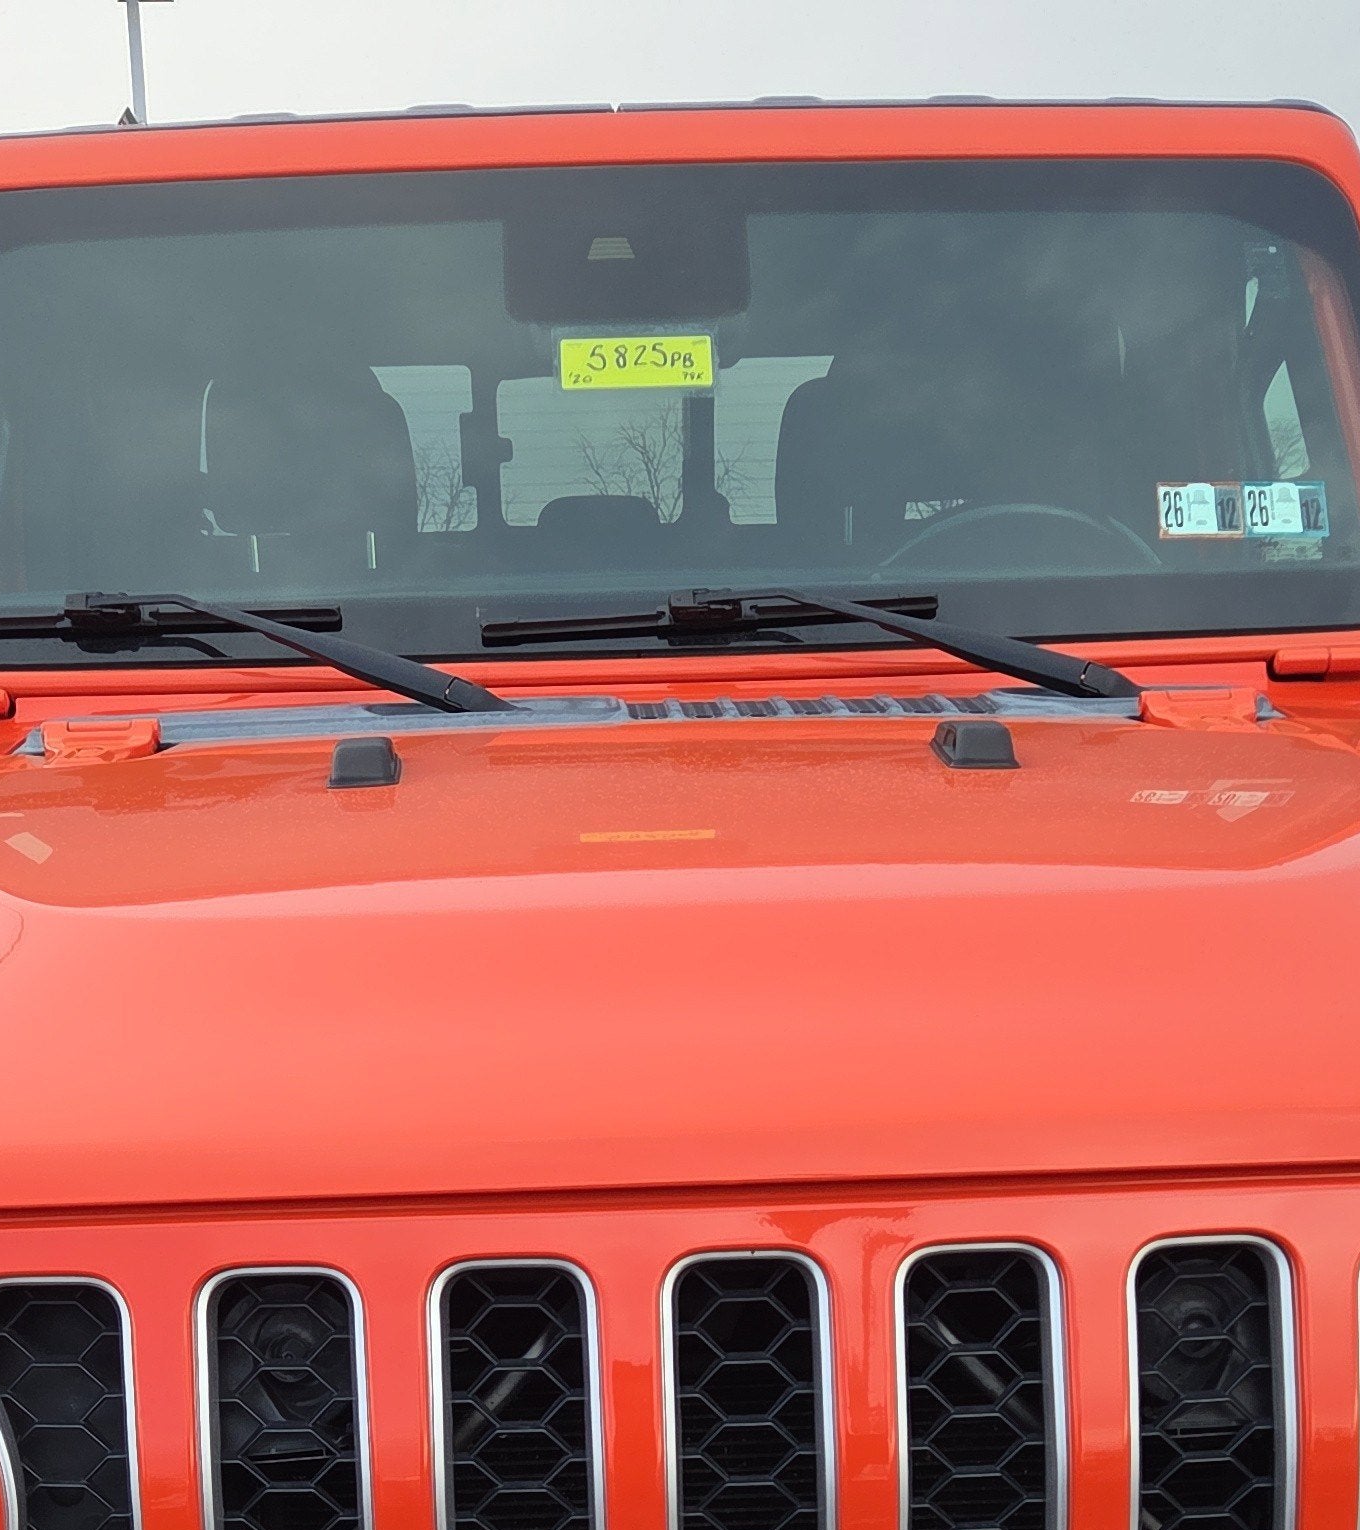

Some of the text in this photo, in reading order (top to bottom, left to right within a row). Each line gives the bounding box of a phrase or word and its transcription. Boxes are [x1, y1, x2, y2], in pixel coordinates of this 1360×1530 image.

[1162, 490, 1184, 528] 26
[1217, 496, 1240, 530] 12
[1247, 489, 1270, 527] 26
[1301, 497, 1324, 530] 12
